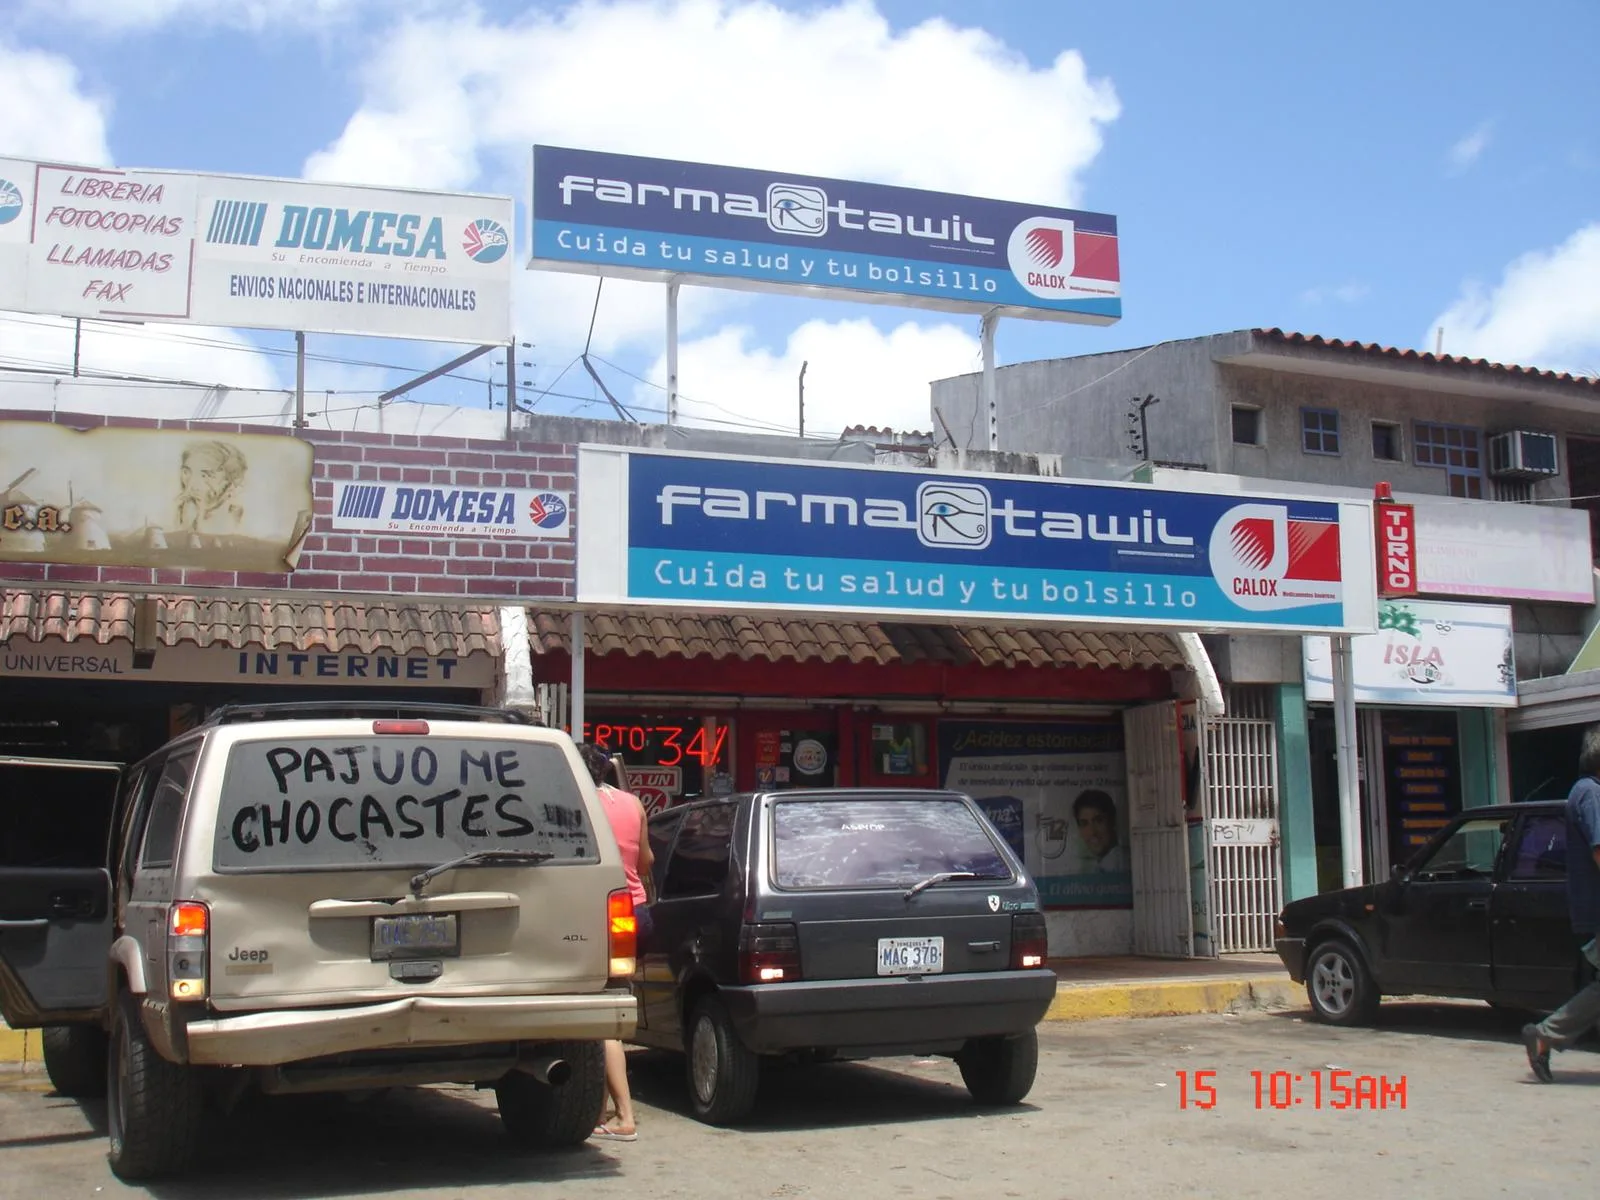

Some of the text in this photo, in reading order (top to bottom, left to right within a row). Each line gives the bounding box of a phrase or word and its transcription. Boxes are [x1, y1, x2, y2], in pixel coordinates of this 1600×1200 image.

[61, 176, 165, 204] LIBRERIA
[558, 175, 768, 219] farma
[45, 206, 183, 237] FOTOCOPIAS
[275, 204, 447, 260] DOMESA
[46, 243, 174, 273] LLAMADAS
[271, 252, 447, 275] Su Encomienda a Tiempo
[557, 229, 998, 294] Cuida tu salud y tu bolsillo
[82, 280, 134, 303] FAX
[229, 274, 476, 311] ENVIOS NACIONALES E INTERNACIONALES
[1027, 271, 1067, 290] CALOX
[391, 487, 515, 525] DOMESA
[656, 484, 918, 530] farma
[388, 522, 400, 530] Su
[409, 523, 466, 533] Encomienda
[483, 526, 517, 535] Tiempo
[1385, 510, 1411, 589] TURNO
[654, 559, 1197, 609] Cuida tu salud y tu bolsillo
[1233, 577, 1278, 598] CALOX
[5, 655, 124, 674] UNIVERSAL
[239, 651, 459, 681] INTERNET
[1383, 643, 1445, 667] ISLA
[266, 746, 526, 794] PAJUO ME
[647, 774, 671, 786] UN
[231, 788, 535, 853] CHOCASTES
[229, 946, 269, 963] Jeep
[883, 946, 938, 966] MAG 37B
